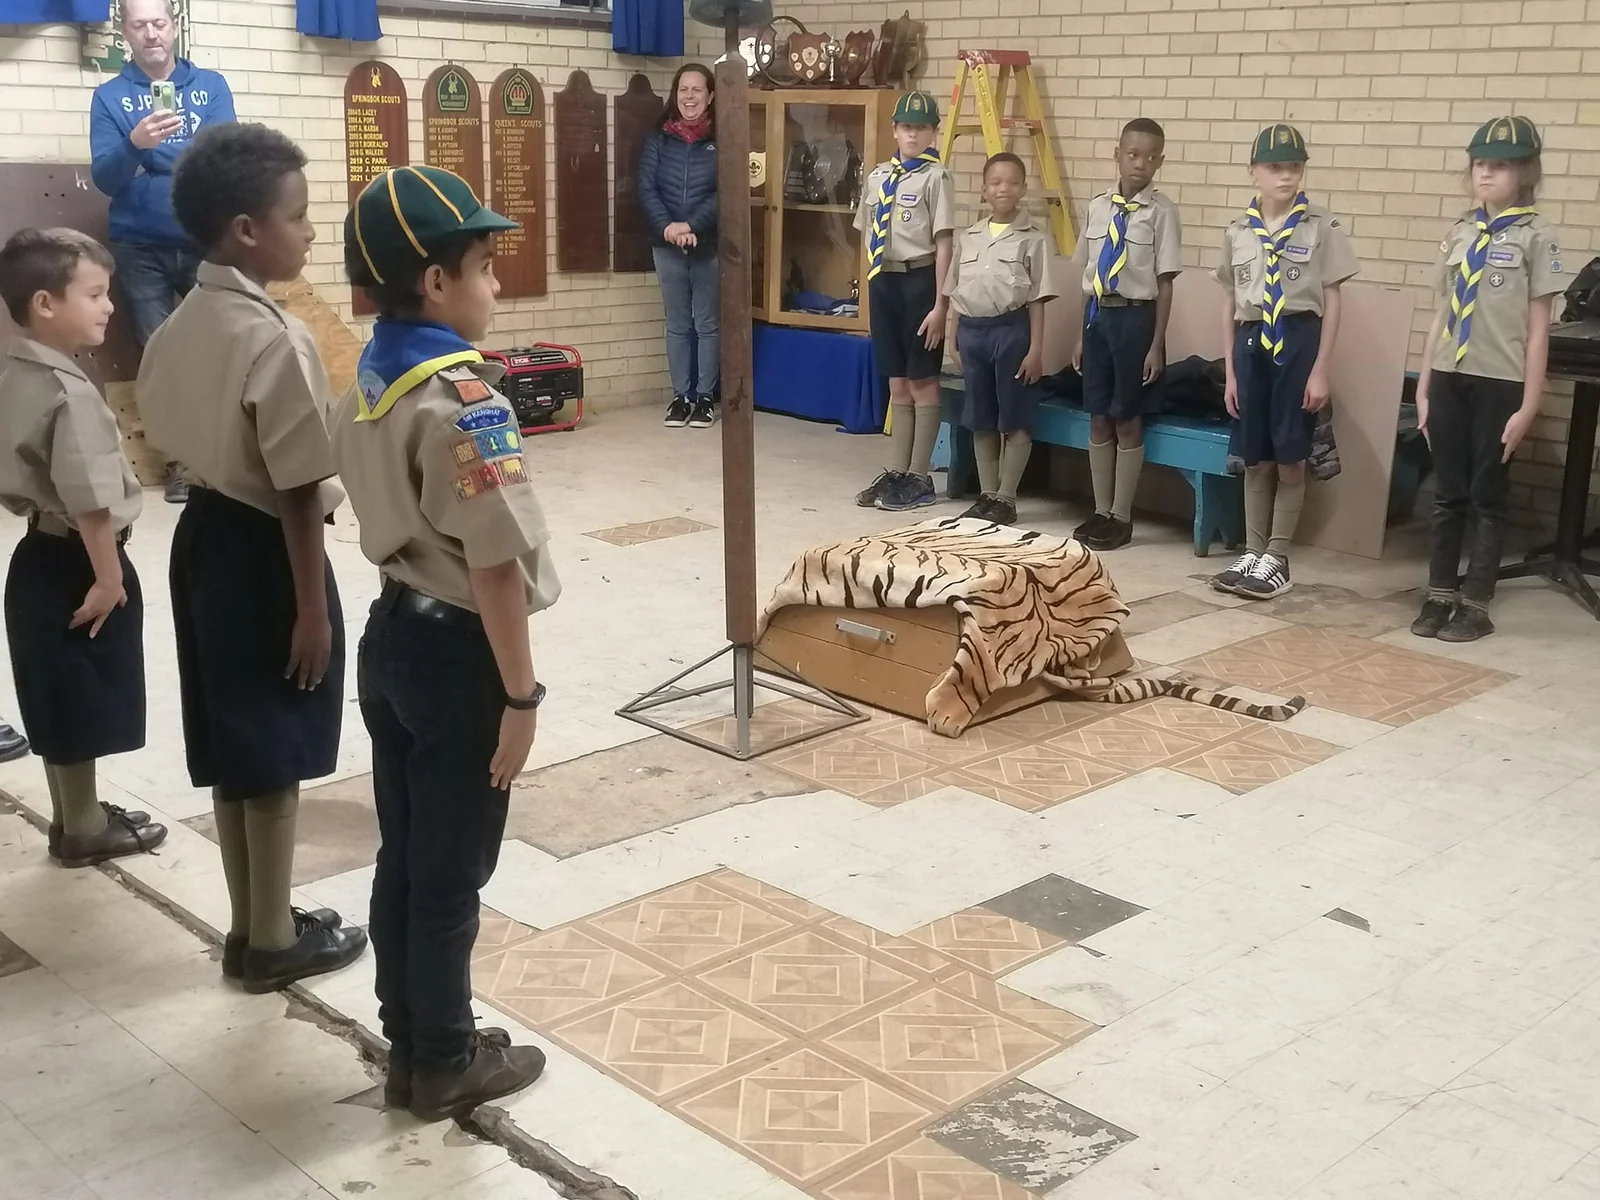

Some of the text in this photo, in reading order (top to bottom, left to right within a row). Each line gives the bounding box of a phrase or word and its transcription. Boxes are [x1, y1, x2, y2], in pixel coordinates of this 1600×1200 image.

[352, 95, 400, 104] SPRINGBOK SCOUTS
[520, 120, 542, 128] SCOUTS
[371, 157, 388, 165] PARK
[350, 174, 363, 182] 2021
